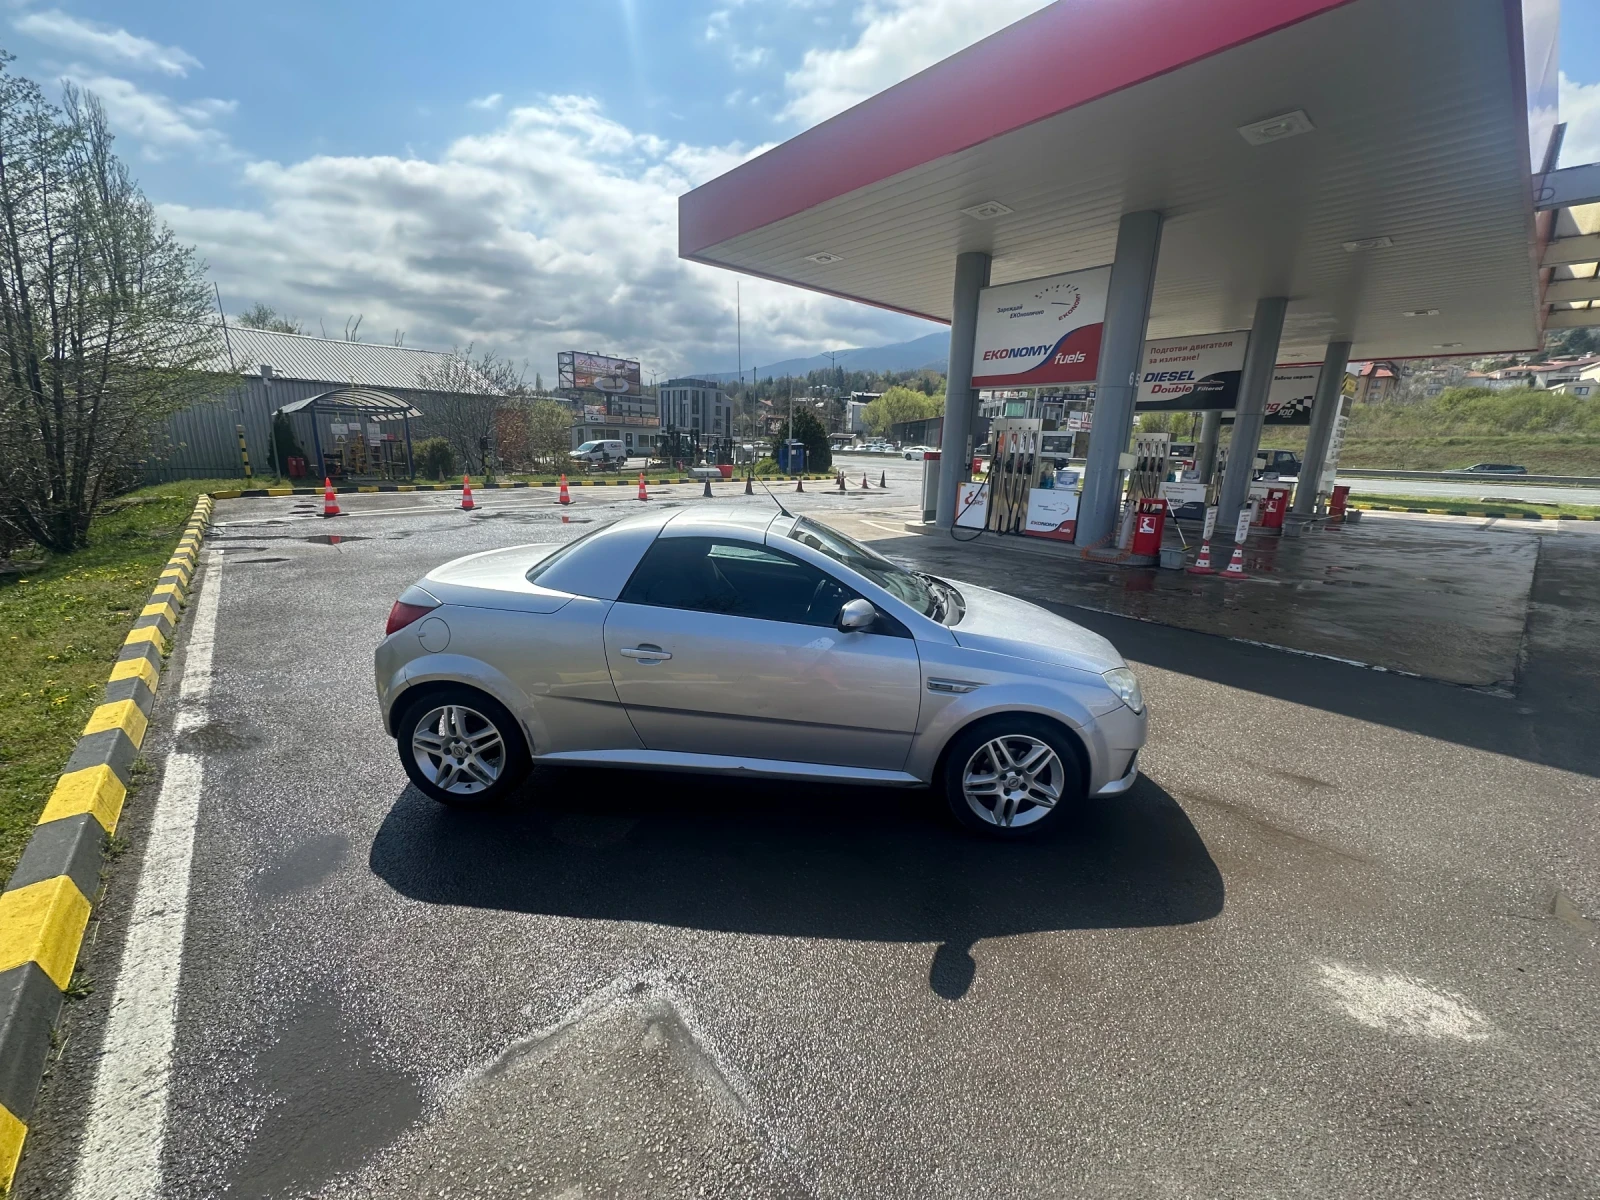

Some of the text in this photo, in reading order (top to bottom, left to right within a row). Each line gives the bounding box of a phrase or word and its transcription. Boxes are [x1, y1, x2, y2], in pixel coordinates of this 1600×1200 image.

[983, 344, 1053, 361] EKONOMY
[1150, 340, 1233, 355] Подготви двигателя
[1054, 350, 1086, 365] fuels
[1149, 353, 1200, 365] за излитане!
[1143, 370, 1196, 383] DIESEL
[1150, 384, 1193, 394] Double
[1030, 520, 1058, 528] EKONOMY
